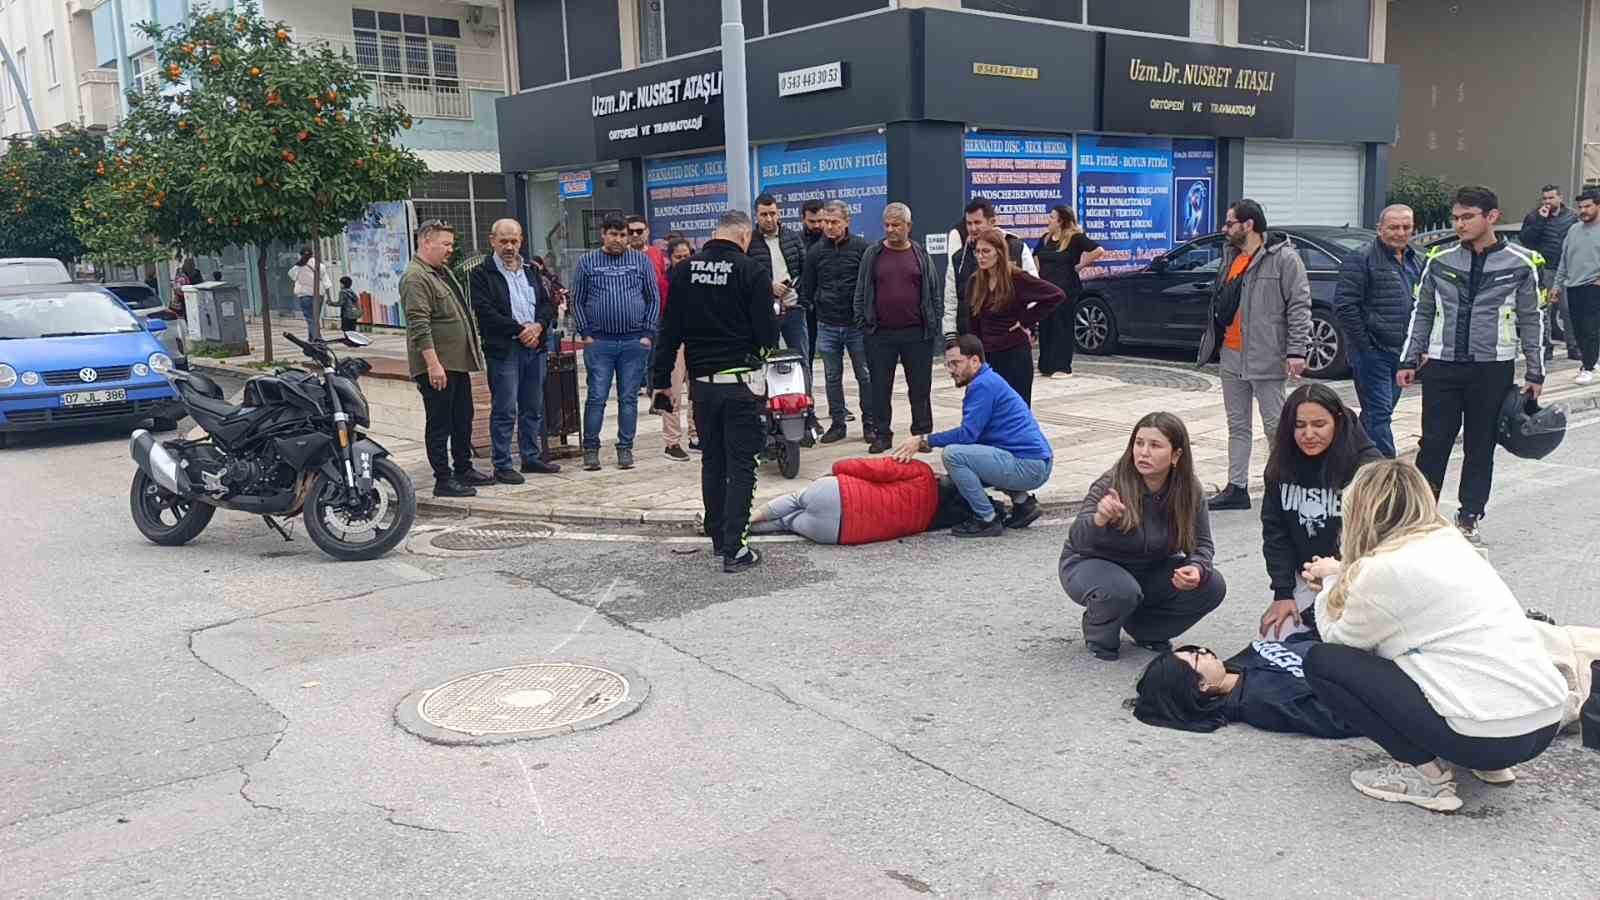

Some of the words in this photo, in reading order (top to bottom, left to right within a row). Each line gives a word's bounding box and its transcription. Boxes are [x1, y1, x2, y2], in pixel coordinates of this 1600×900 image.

[682, 71, 723, 104] ATAŞLI
[1234, 68, 1276, 96] ATAŞLI
[1150, 98, 1184, 111] ORTOPEDİ
[1192, 101, 1203, 113] VE
[1210, 102, 1256, 117] TRAVMATOLOJİ
[608, 123, 639, 141] ORTOPEDİ
[641, 123, 652, 136] VE
[653, 114, 704, 134] TRAVMATOLOJİ
[1004, 140, 1020, 152] DISC
[761, 164, 781, 177] BEL
[819, 156, 855, 172] BOYUN
[826, 189, 837, 200] VE
[970, 189, 1063, 200] BANDSCHEIBENVORFALL
[992, 204, 1047, 214] ACKENHERNIE
[690, 260, 734, 273] TRAFİK
[691, 272, 728, 285] POLİSİ
[66, 394, 79, 404] 07
[104, 390, 125, 401] 386
